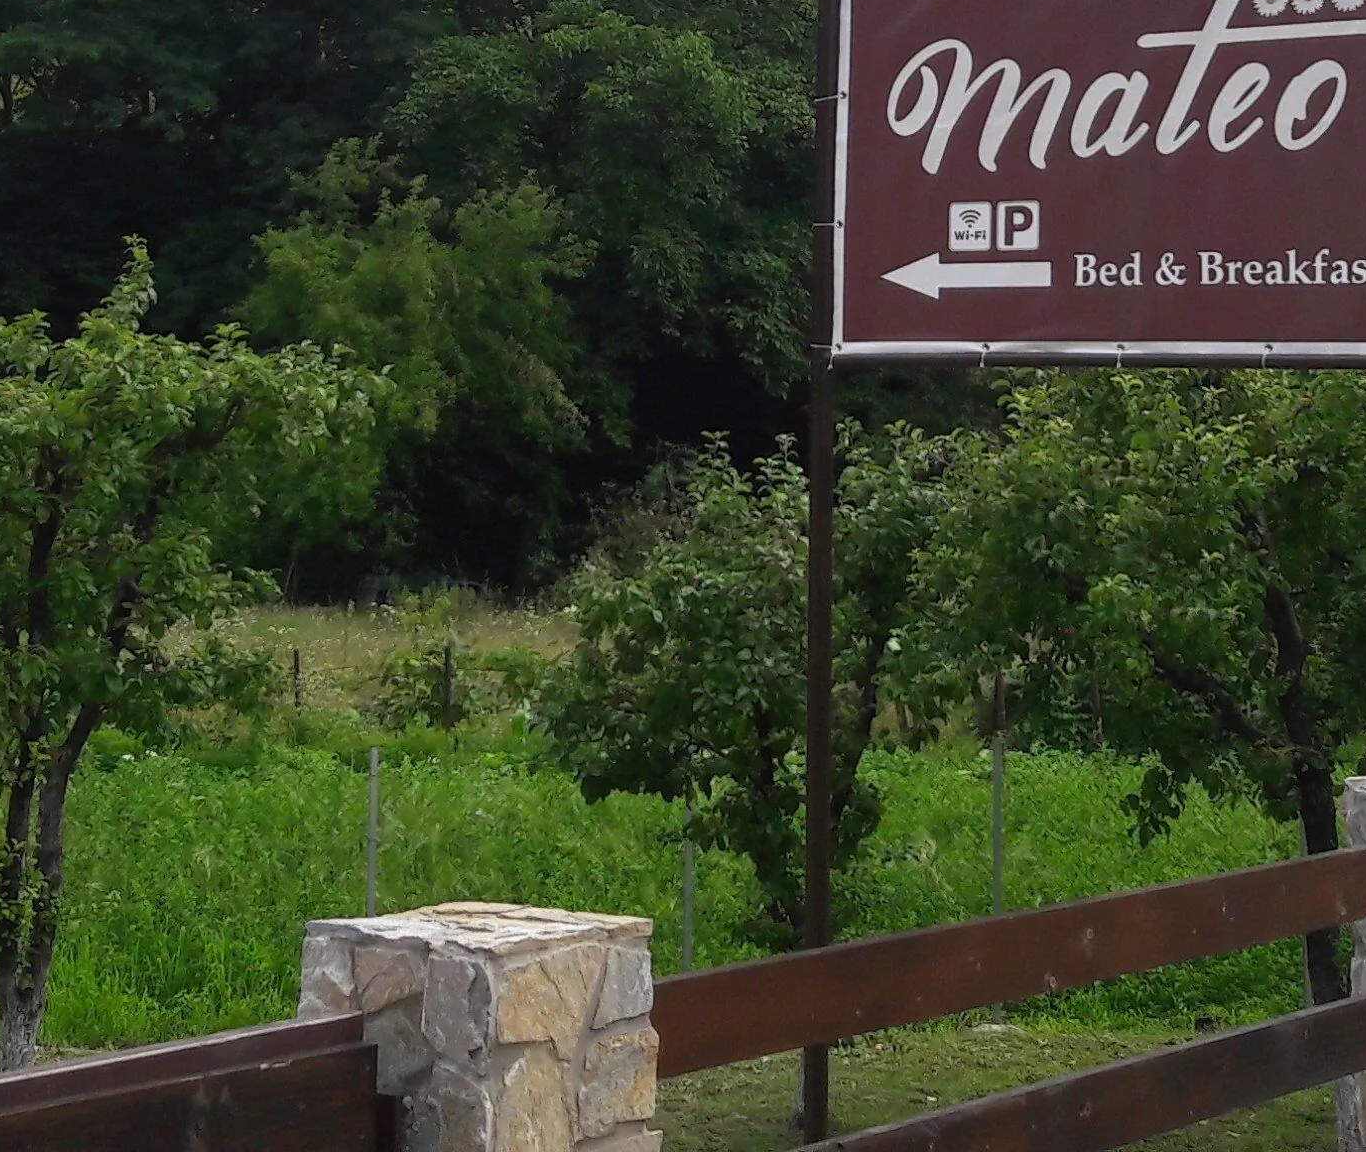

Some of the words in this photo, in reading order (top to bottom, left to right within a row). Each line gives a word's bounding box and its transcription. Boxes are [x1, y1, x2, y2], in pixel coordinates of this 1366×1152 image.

[1004, 205, 1033, 246] P
[1073, 251, 1144, 287] Bed
[1155, 252, 1187, 286] &
